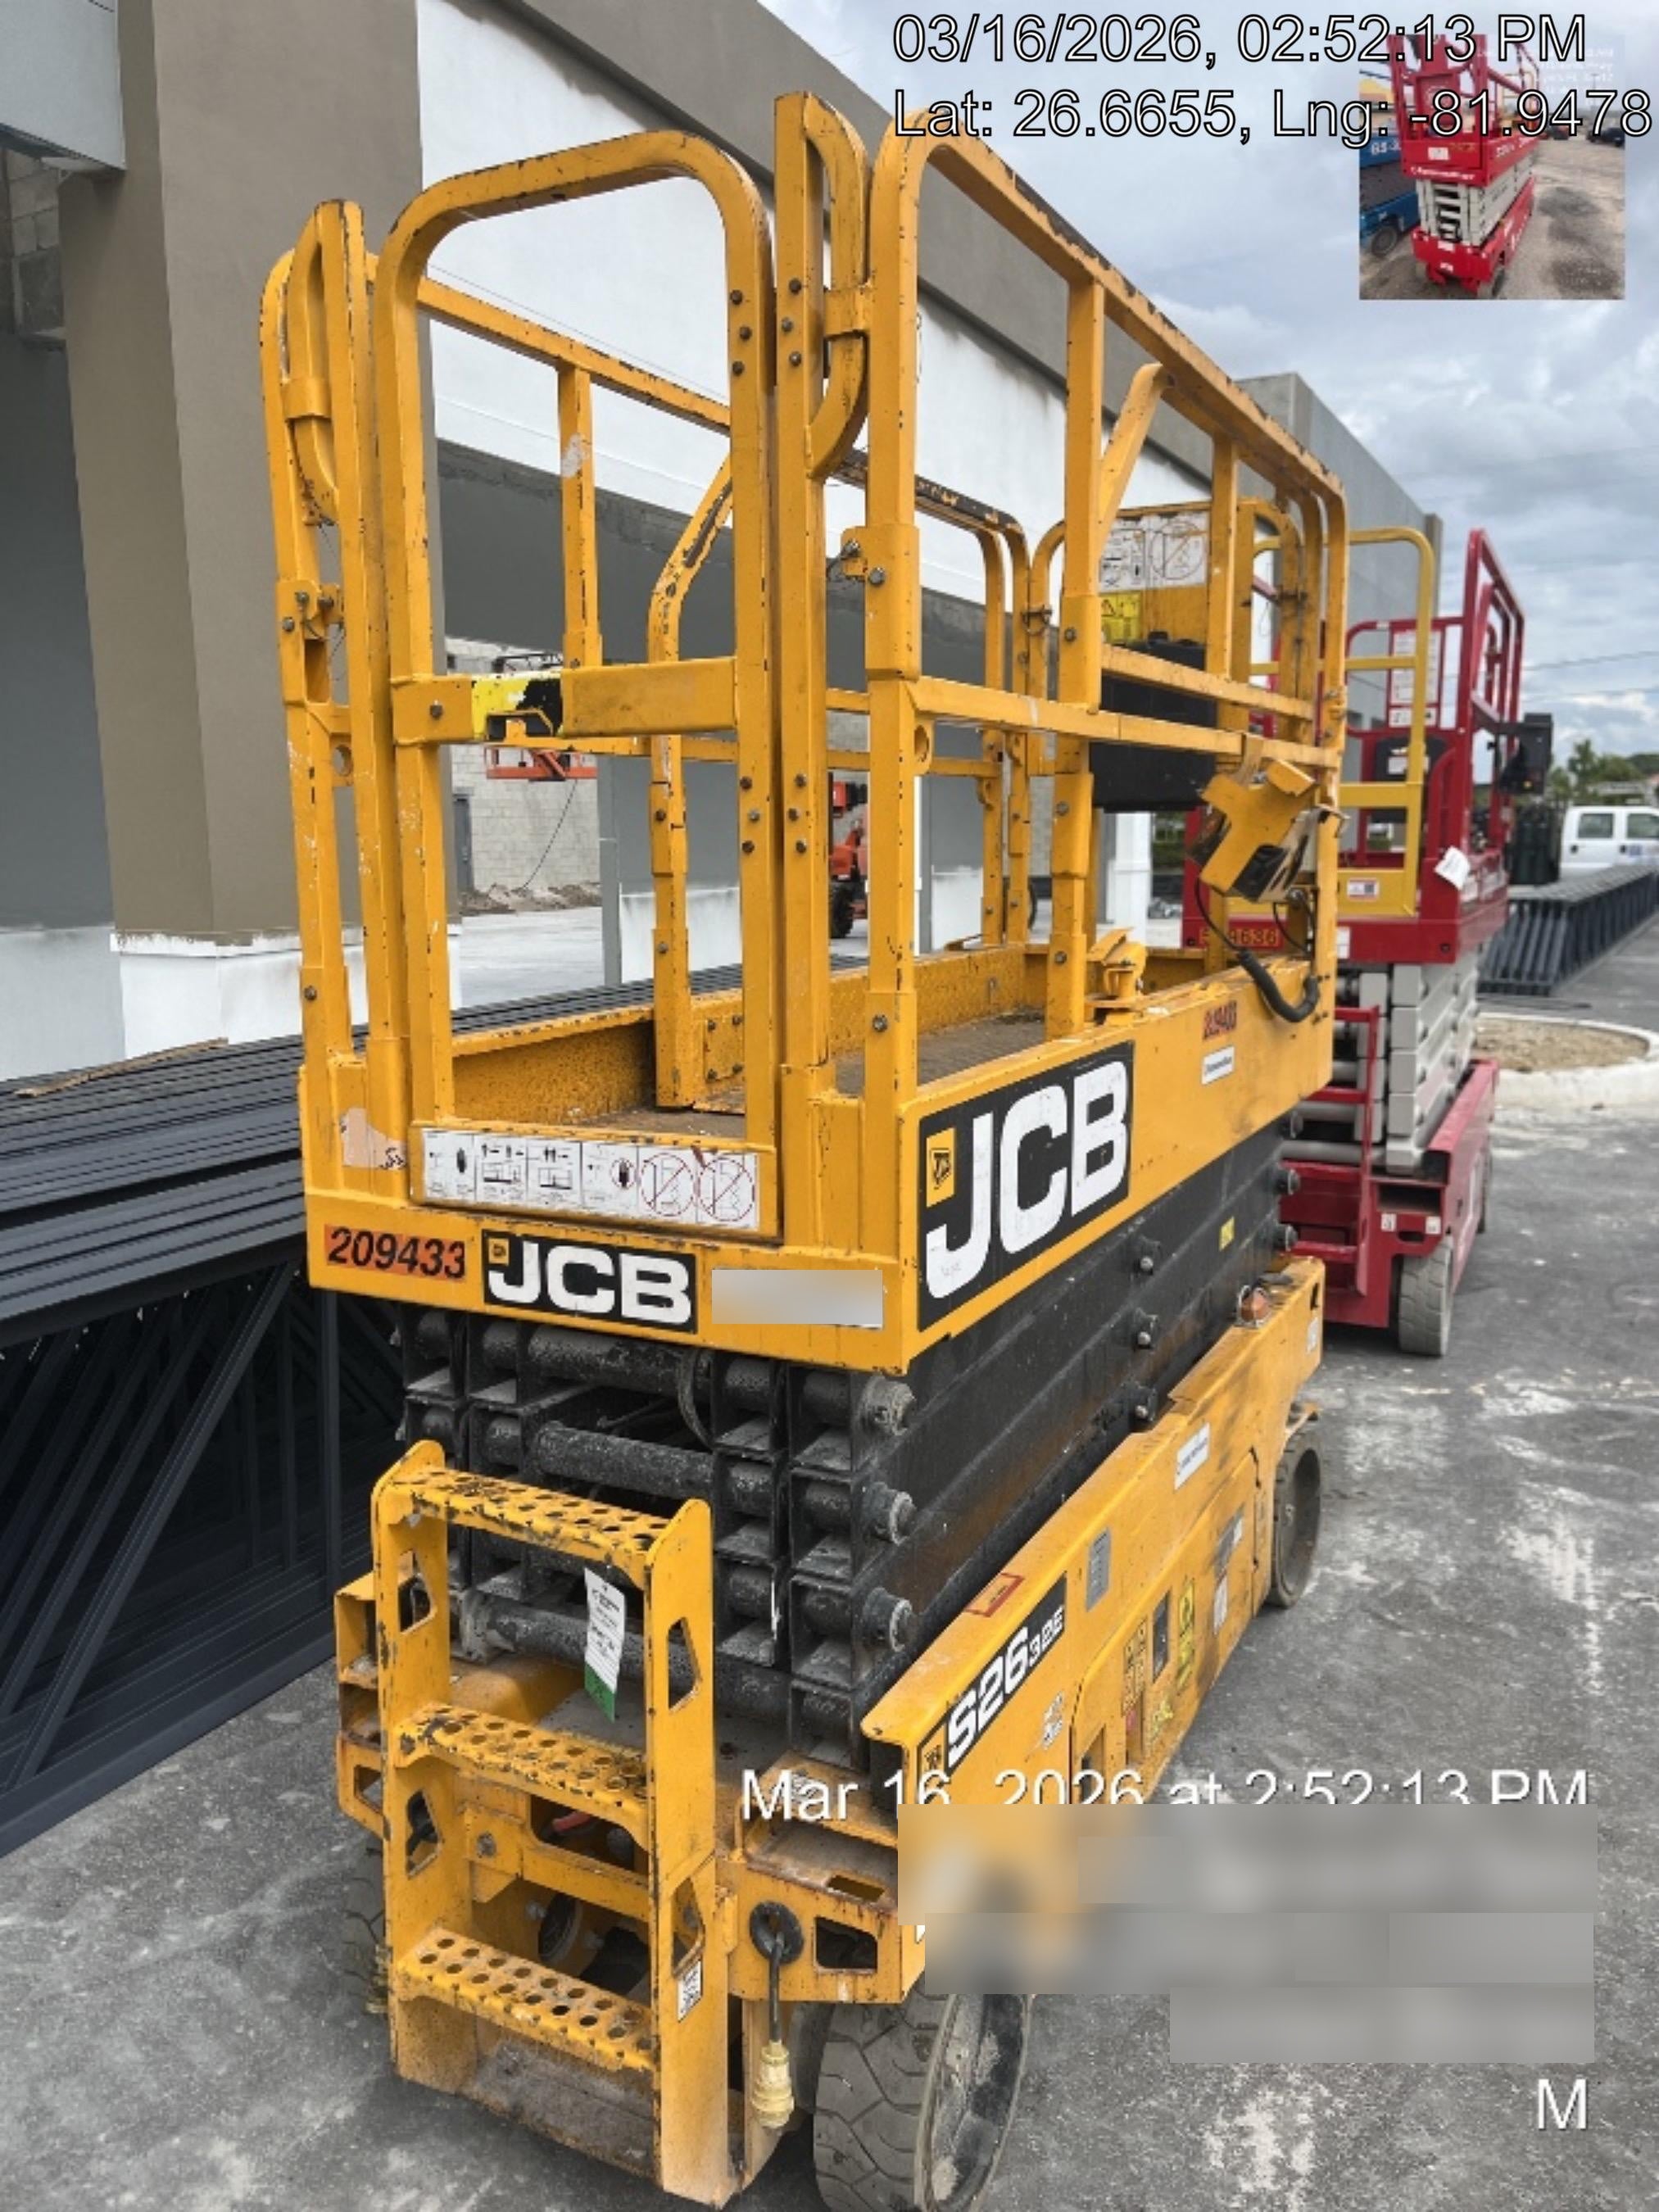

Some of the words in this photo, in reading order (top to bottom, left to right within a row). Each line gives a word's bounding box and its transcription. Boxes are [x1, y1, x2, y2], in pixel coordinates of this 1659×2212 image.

[926, 1061, 1130, 1299] JCB
[327, 1228, 467, 1280] 209433
[487, 1240, 691, 1325] JCB
